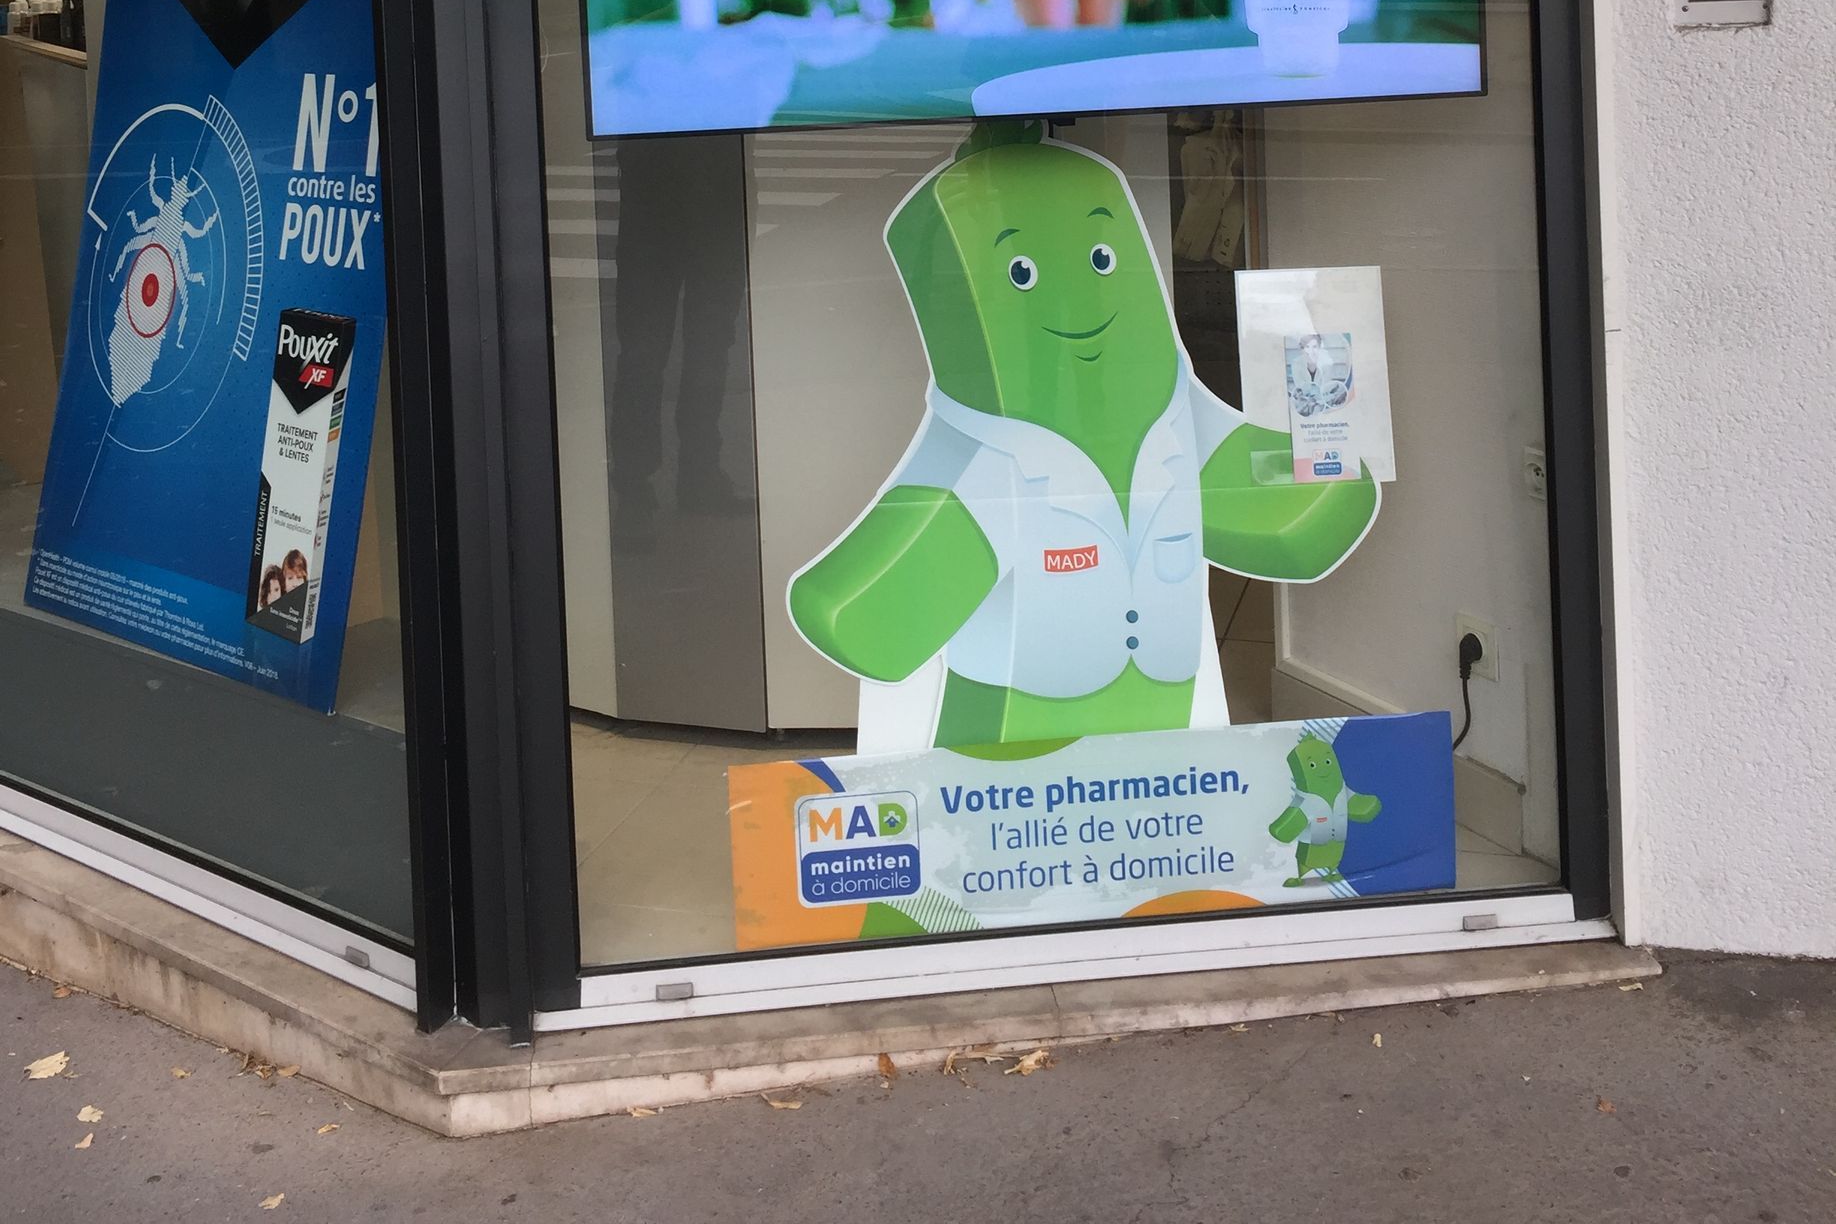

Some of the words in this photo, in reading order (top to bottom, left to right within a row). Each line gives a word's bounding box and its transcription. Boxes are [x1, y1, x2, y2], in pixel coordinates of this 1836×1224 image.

[287, 176, 344, 201] contre
[349, 174, 376, 204] les
[304, 368, 328, 389] XF
[277, 423, 318, 441] TRAITEMENT
[278, 435, 314, 453] ANTI-POUX
[285, 449, 310, 464] LENTES
[254, 490, 269, 558] TRAITEMENT
[1047, 550, 1096, 570] MADY
[940, 784, 1034, 814] Votre
[1045, 766, 1249, 812] pharmacien,
[808, 802, 908, 843] MAD
[991, 816, 1068, 851] l'allié
[1078, 814, 1115, 844] de
[1125, 810, 1204, 840] votre
[811, 852, 911, 876] maintien
[962, 859, 1073, 894] confort
[1083, 855, 1099, 884] à
[1109, 846, 1235, 882] domicile
[811, 879, 825, 896] à
[831, 872, 911, 894] domicile
